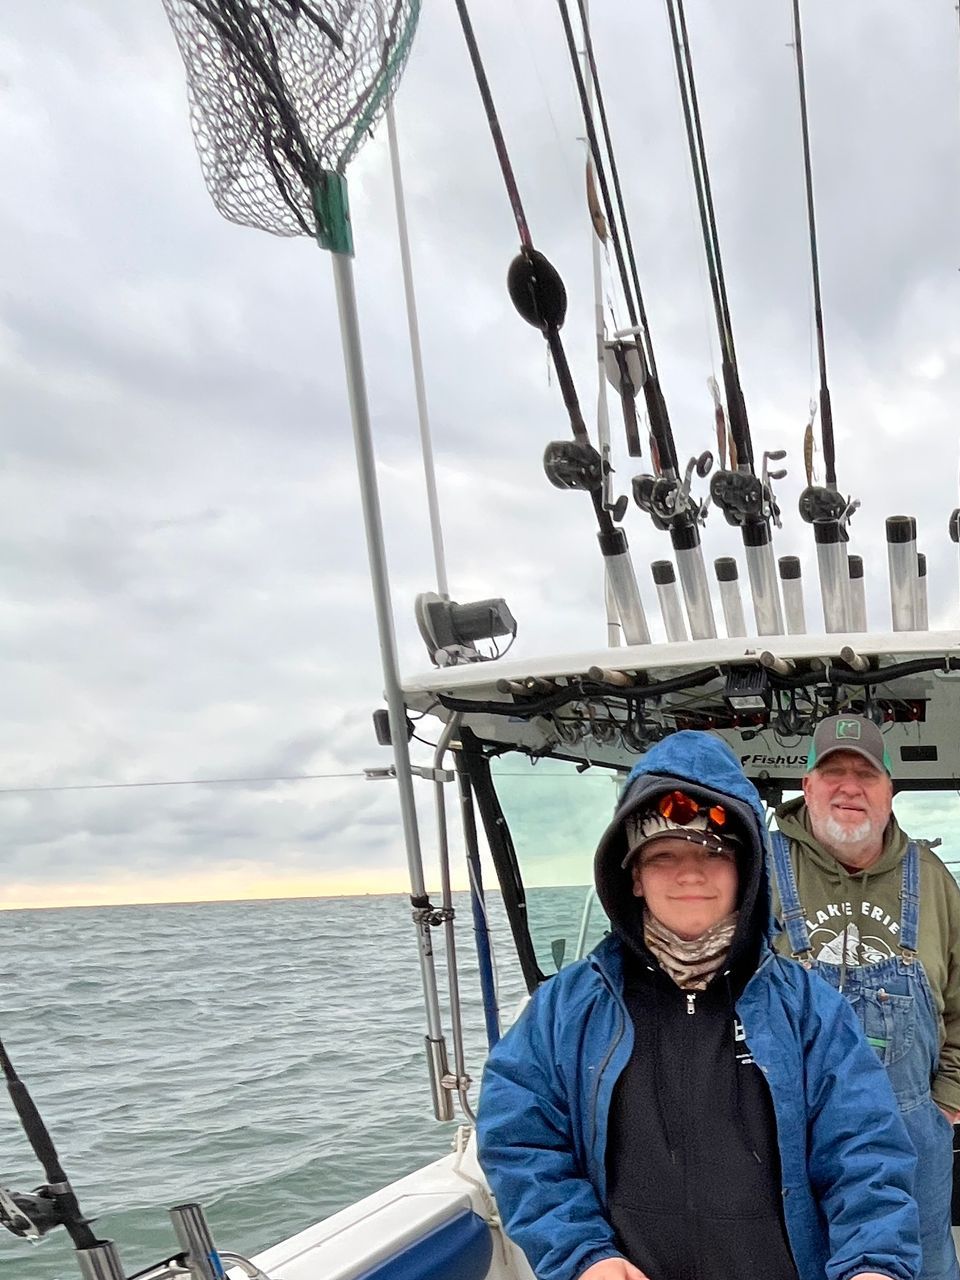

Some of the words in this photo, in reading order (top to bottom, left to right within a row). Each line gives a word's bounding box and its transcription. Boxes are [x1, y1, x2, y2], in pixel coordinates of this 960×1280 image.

[752, 755, 808, 765] FishUS
[805, 902, 853, 931] LAKE
[861, 901, 901, 935] ERIE
